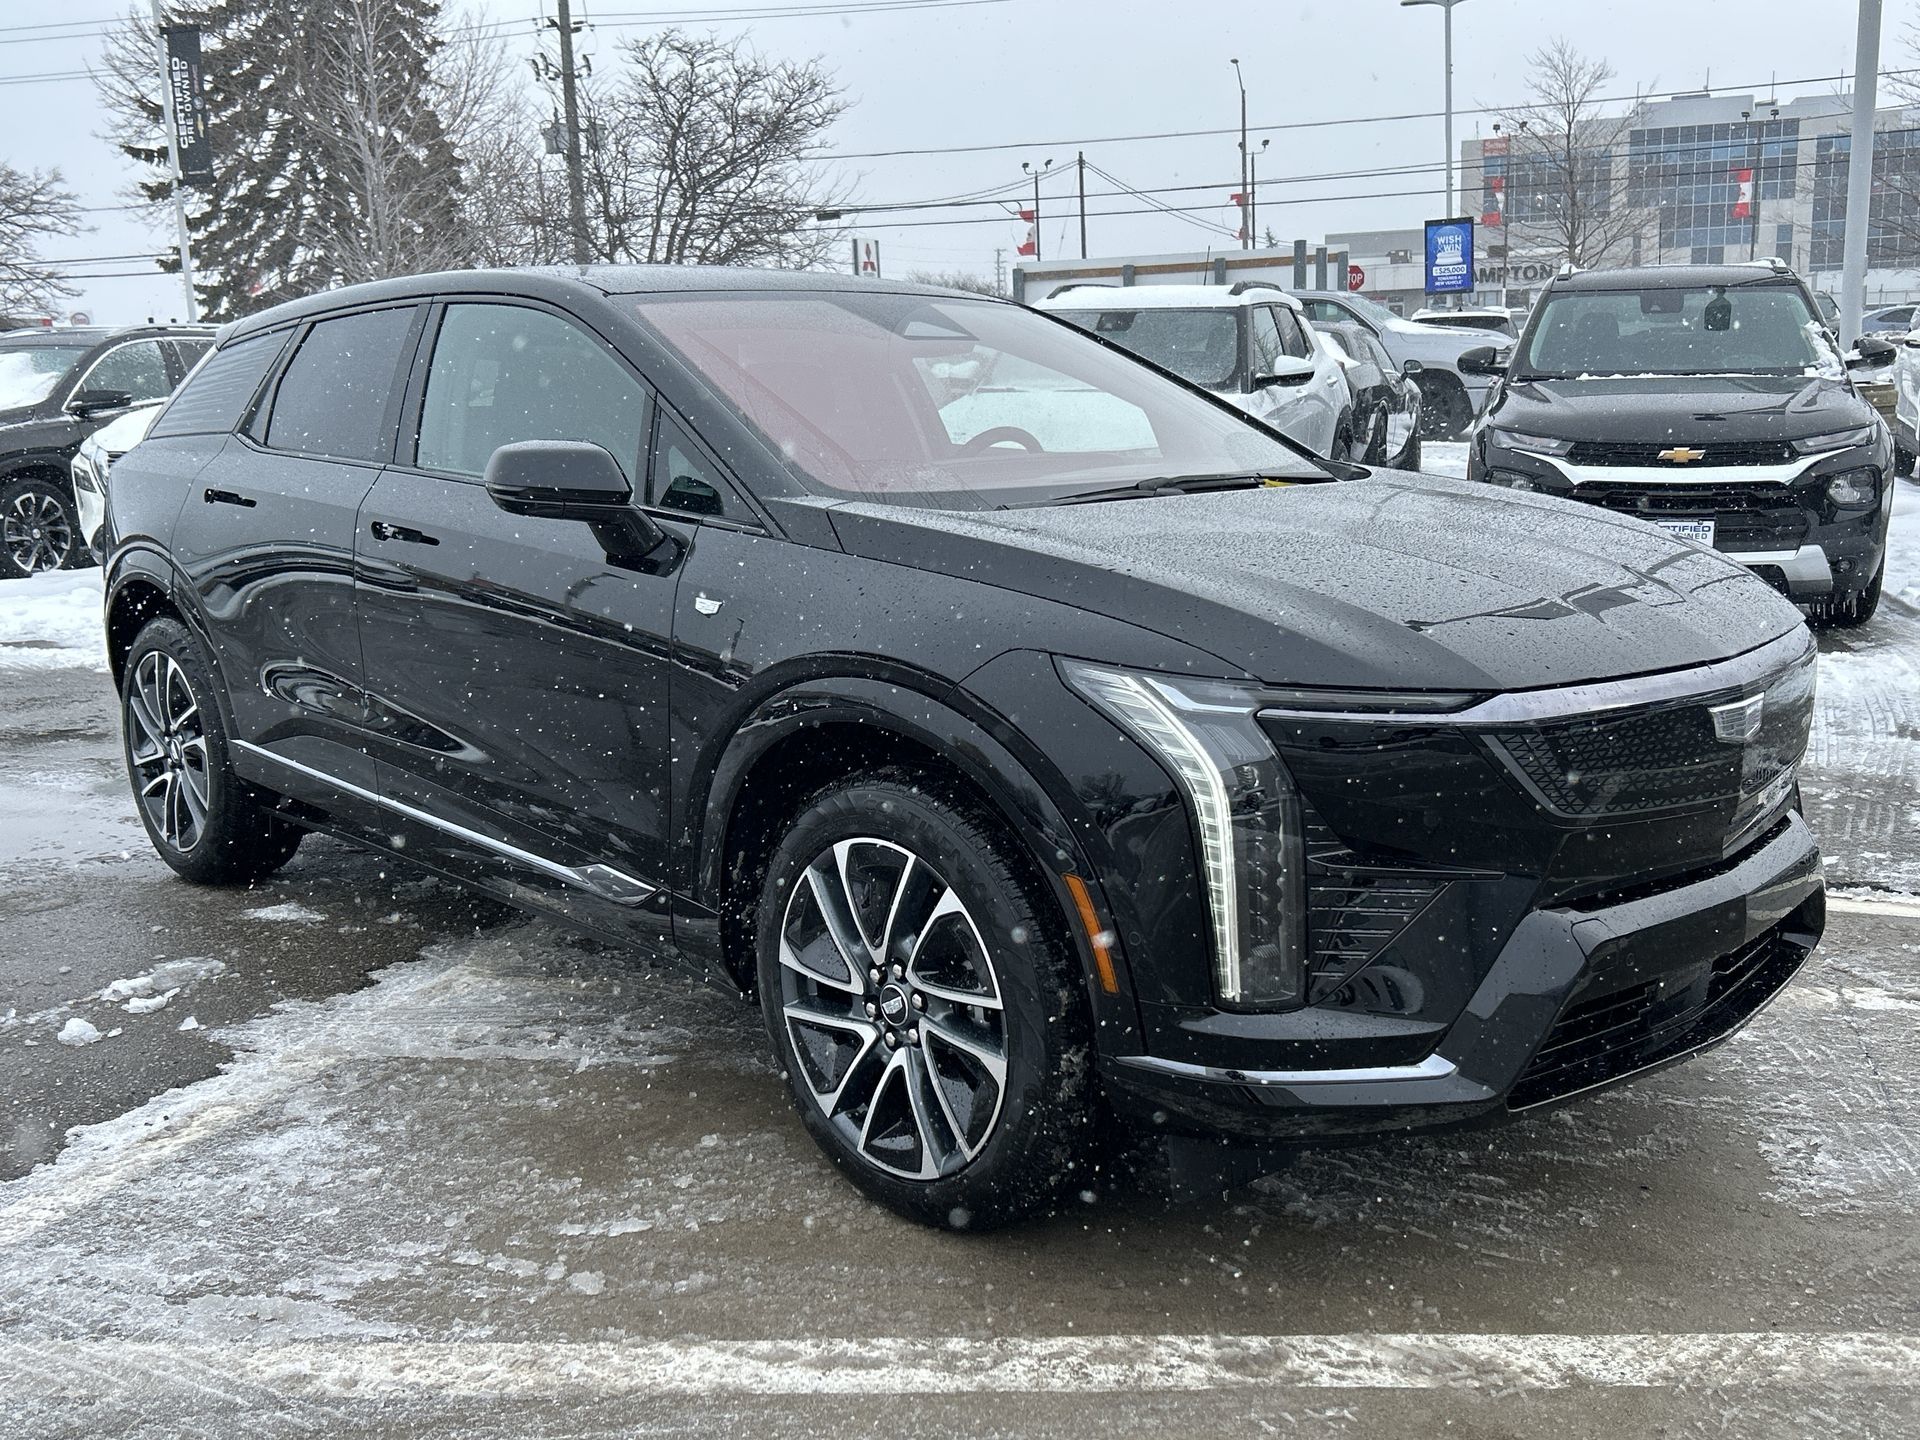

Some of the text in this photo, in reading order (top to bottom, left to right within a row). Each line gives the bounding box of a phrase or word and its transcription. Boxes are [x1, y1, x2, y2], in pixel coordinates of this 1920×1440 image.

[172, 57, 189, 149] CERTIFIED
[180, 61, 195, 144] PRE-OWNED
[1437, 234, 1462, 245] WISH
[1443, 243, 1462, 253] WIN
[1439, 266, 1465, 275] $25,000
[1348, 273, 1363, 285] TOP
